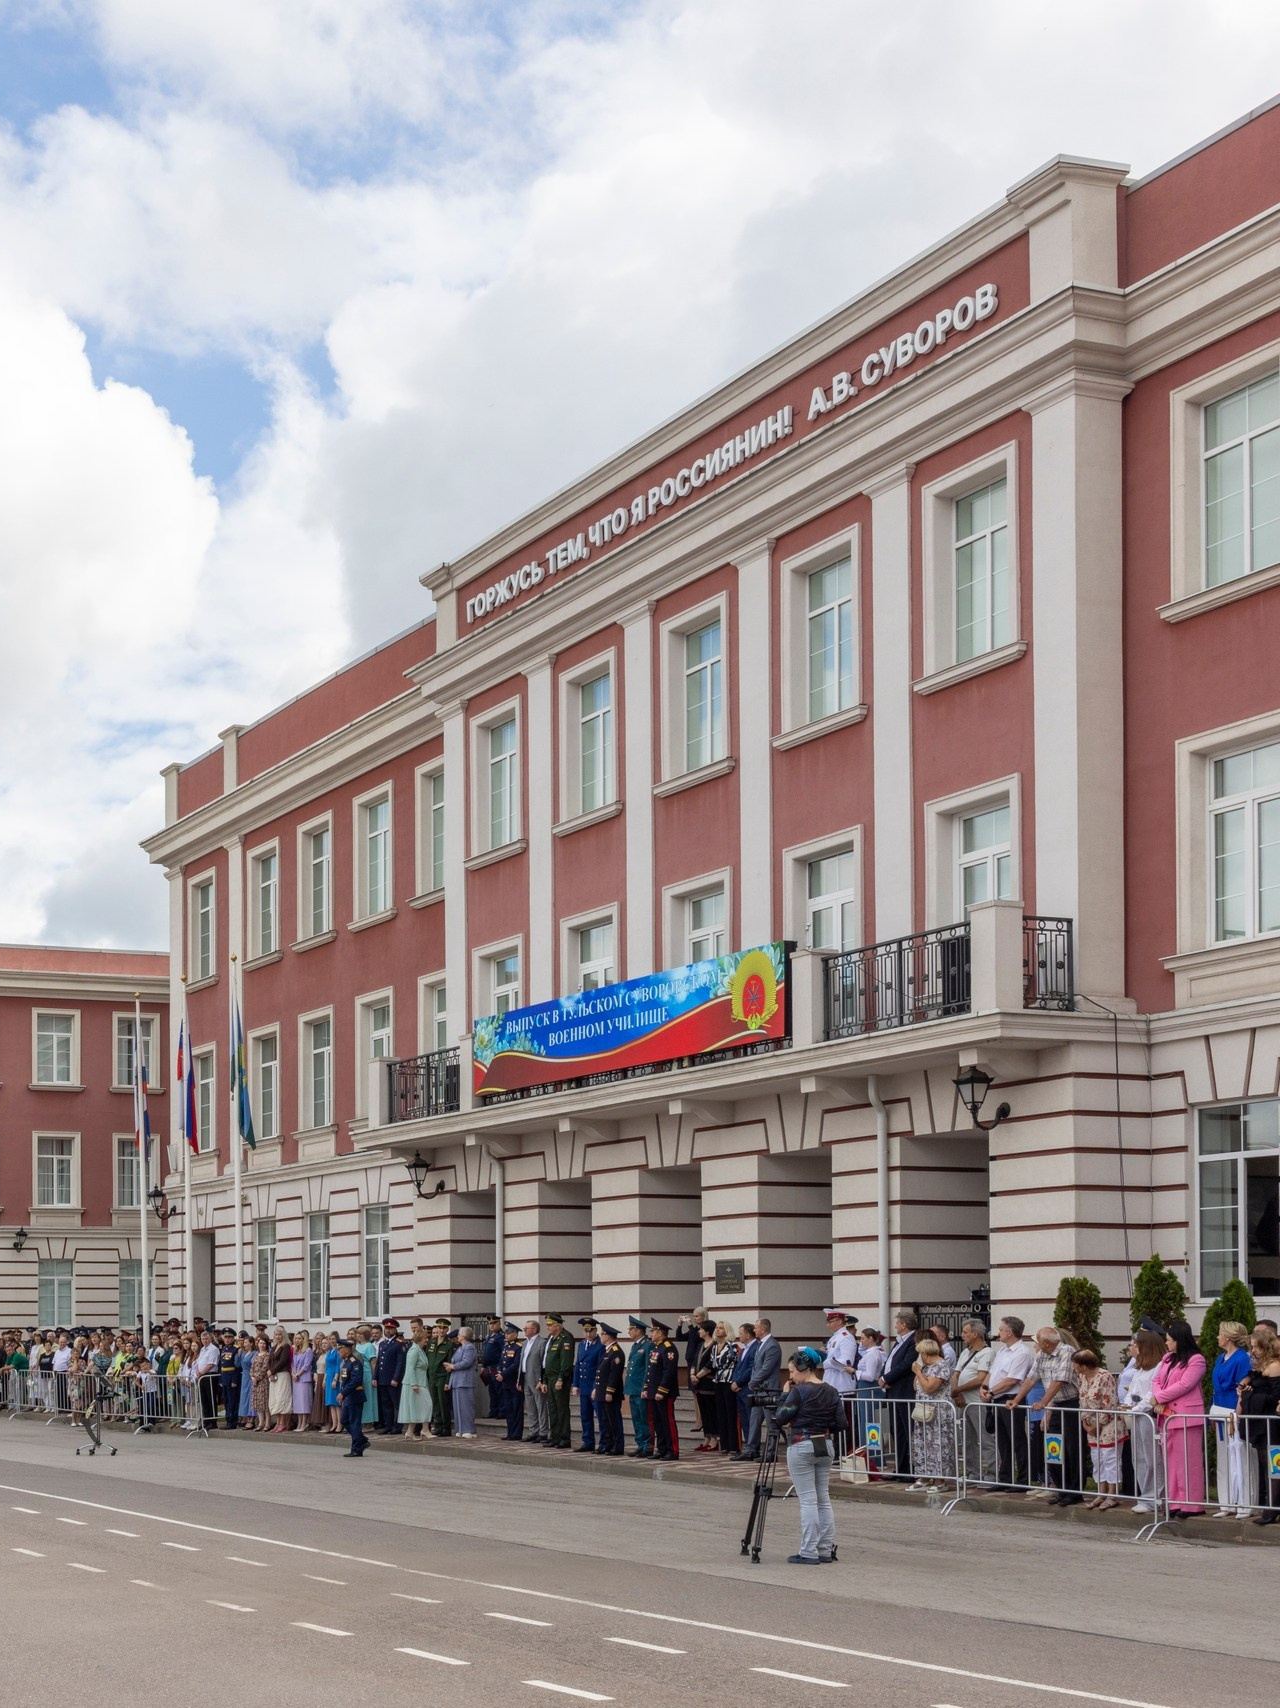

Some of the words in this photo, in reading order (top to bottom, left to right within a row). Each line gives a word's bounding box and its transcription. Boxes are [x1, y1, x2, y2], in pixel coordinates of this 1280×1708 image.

[466, 560, 545, 623] ГОРЖУСЬ
[545, 532, 591, 575] ТЕМ,
[588, 507, 629, 548] ЧТО
[630, 495, 646, 526] Я
[648, 405, 794, 515] РОССИЯНИН!
[807, 371, 858, 421] А.В.
[861, 283, 999, 386] СУВОРОВ
[506, 1011, 551, 1034] ВЫПУСК
[552, 1009, 560, 1024] В
[561, 993, 623, 1021] ТУЛЬСКОМ
[625, 967, 721, 1006] СУВОРОВСКОМ
[548, 1020, 605, 1047] ВОЕННОМ
[607, 1006, 670, 1034] УЧИЛИЩЕ
